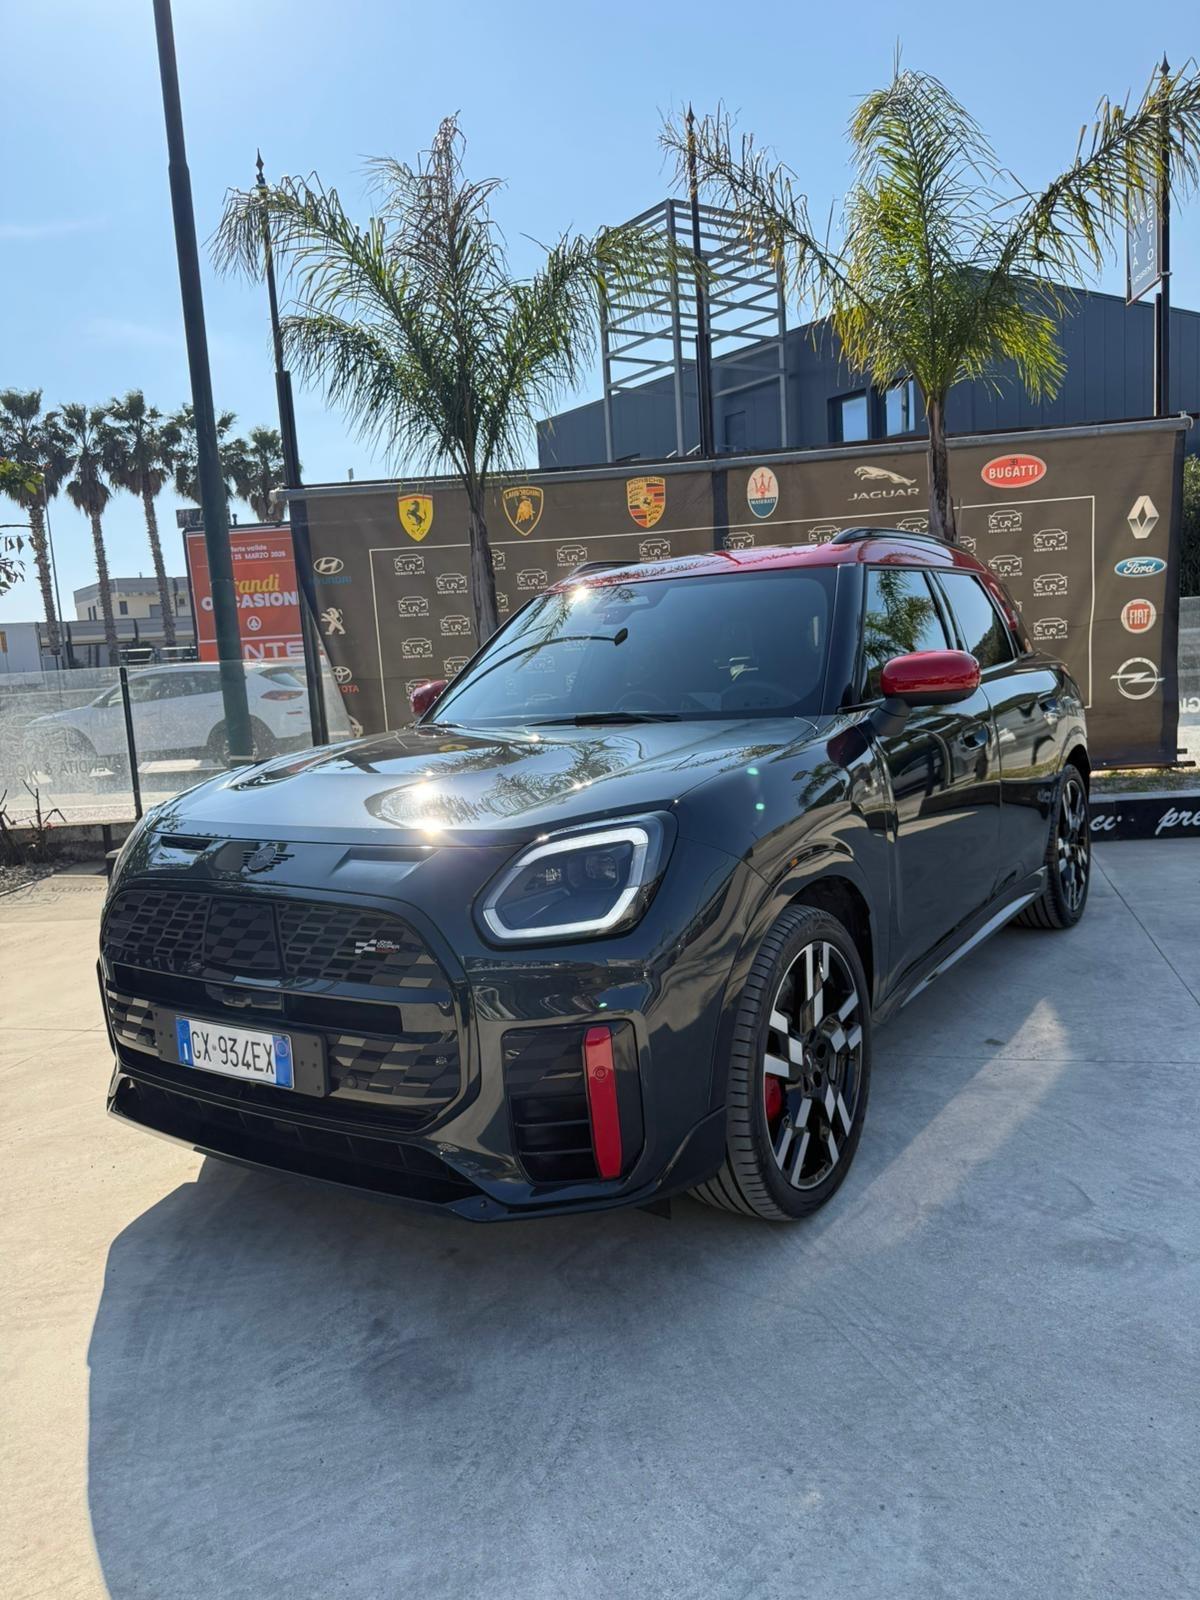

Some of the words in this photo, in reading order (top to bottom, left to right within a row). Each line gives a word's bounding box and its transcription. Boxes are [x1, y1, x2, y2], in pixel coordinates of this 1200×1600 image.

[989, 464, 1038, 480] BUGATTI
[847, 487, 920, 502] JAGUAR
[1123, 560, 1156, 574] Ford
[201, 591, 299, 611] OASION
[1129, 608, 1149, 625] FIAT
[191, 1030, 212, 1062] GX
[218, 1035, 275, 1075] 934EX
